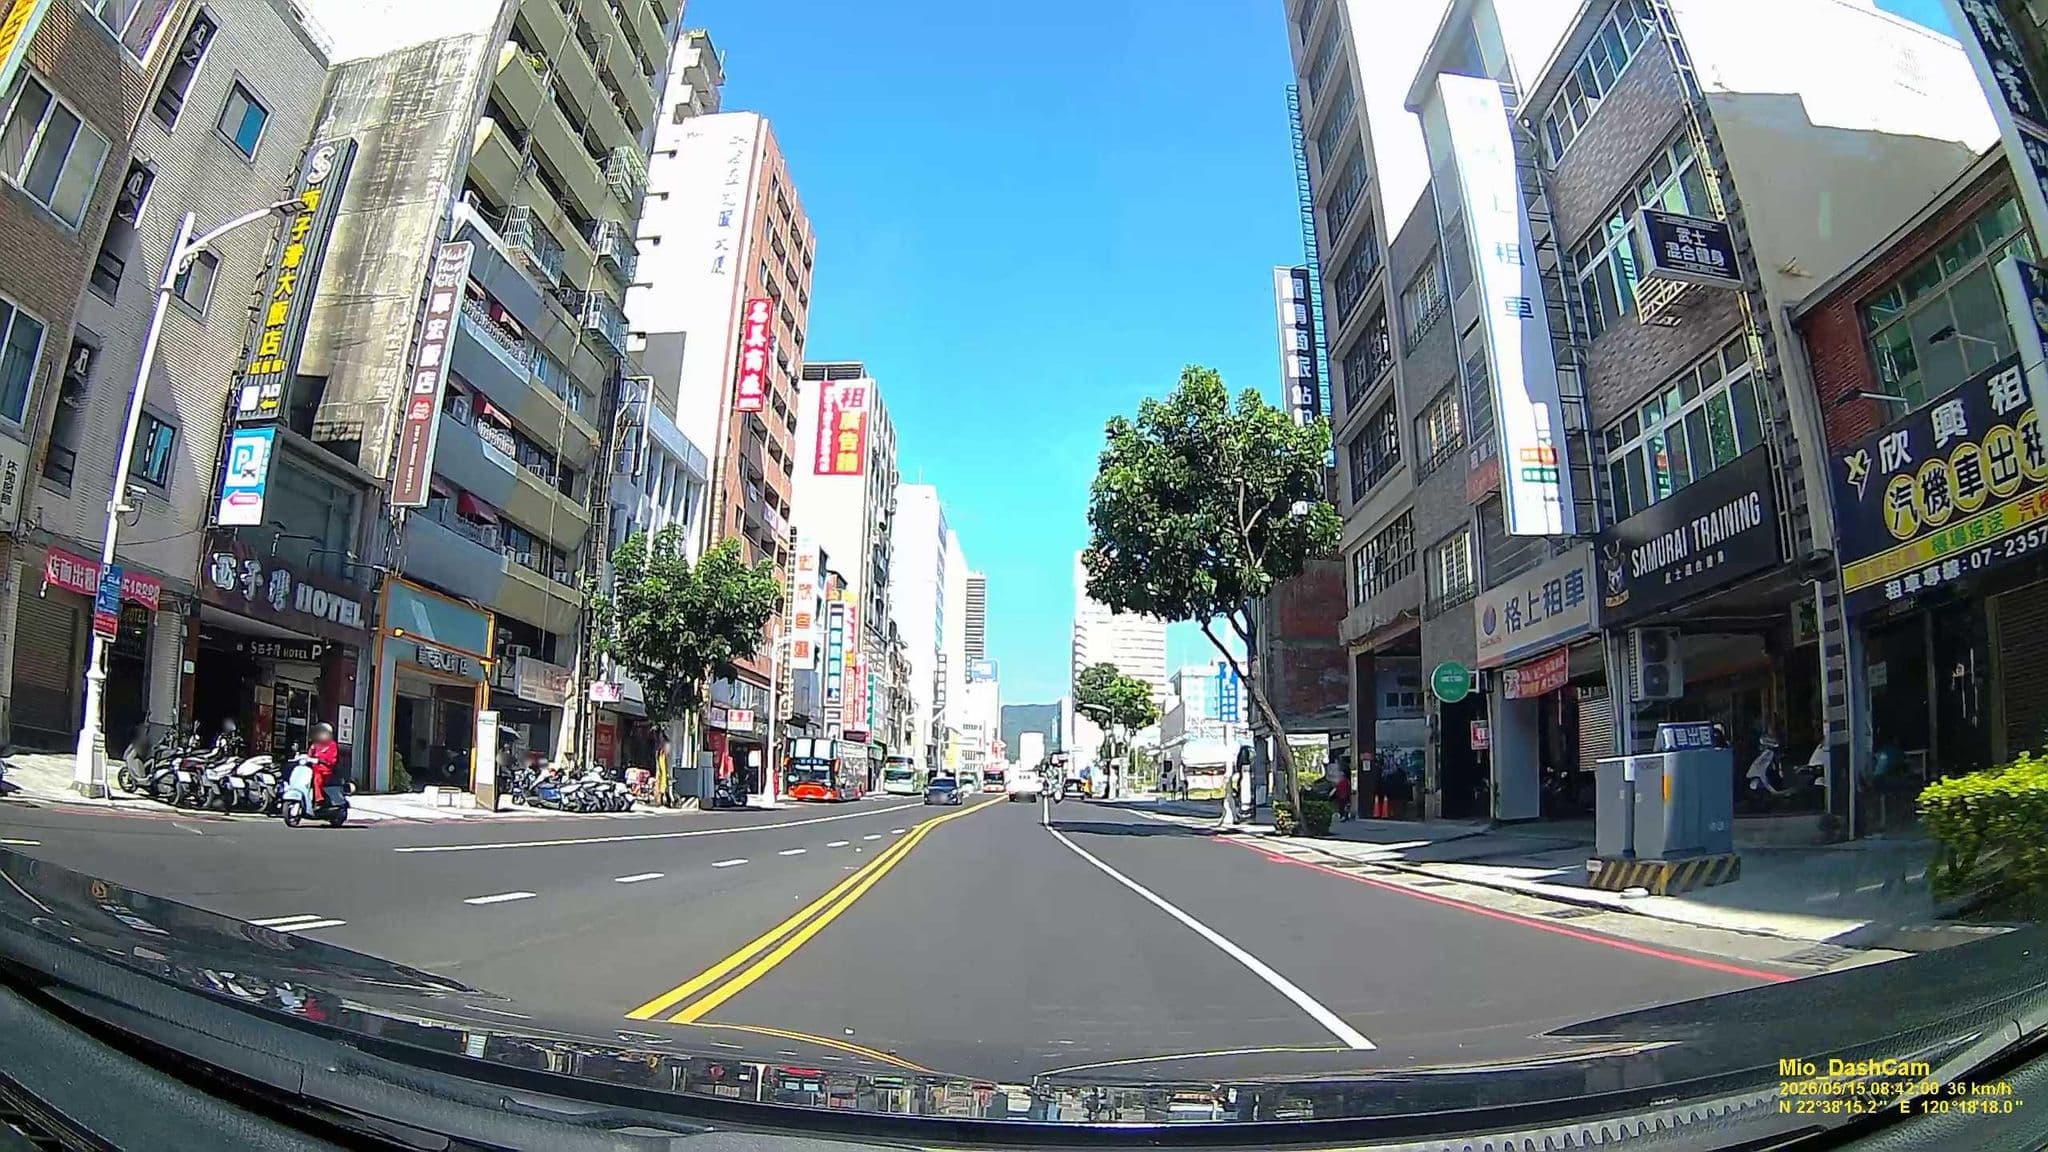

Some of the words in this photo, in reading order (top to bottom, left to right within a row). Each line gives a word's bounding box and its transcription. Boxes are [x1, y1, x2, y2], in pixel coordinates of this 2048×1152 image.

[1664, 241, 1725, 267] 混合健身
[1676, 226, 1708, 247] 武士
[1631, 526, 1689, 578] SAMURAI
[1691, 491, 1761, 552] TRAINING
[295, 582, 365, 631] HOTEL
[1503, 567, 1585, 635] 格上租車
[283, 650, 308, 660] HOTEL
[311, 644, 322, 660] P
